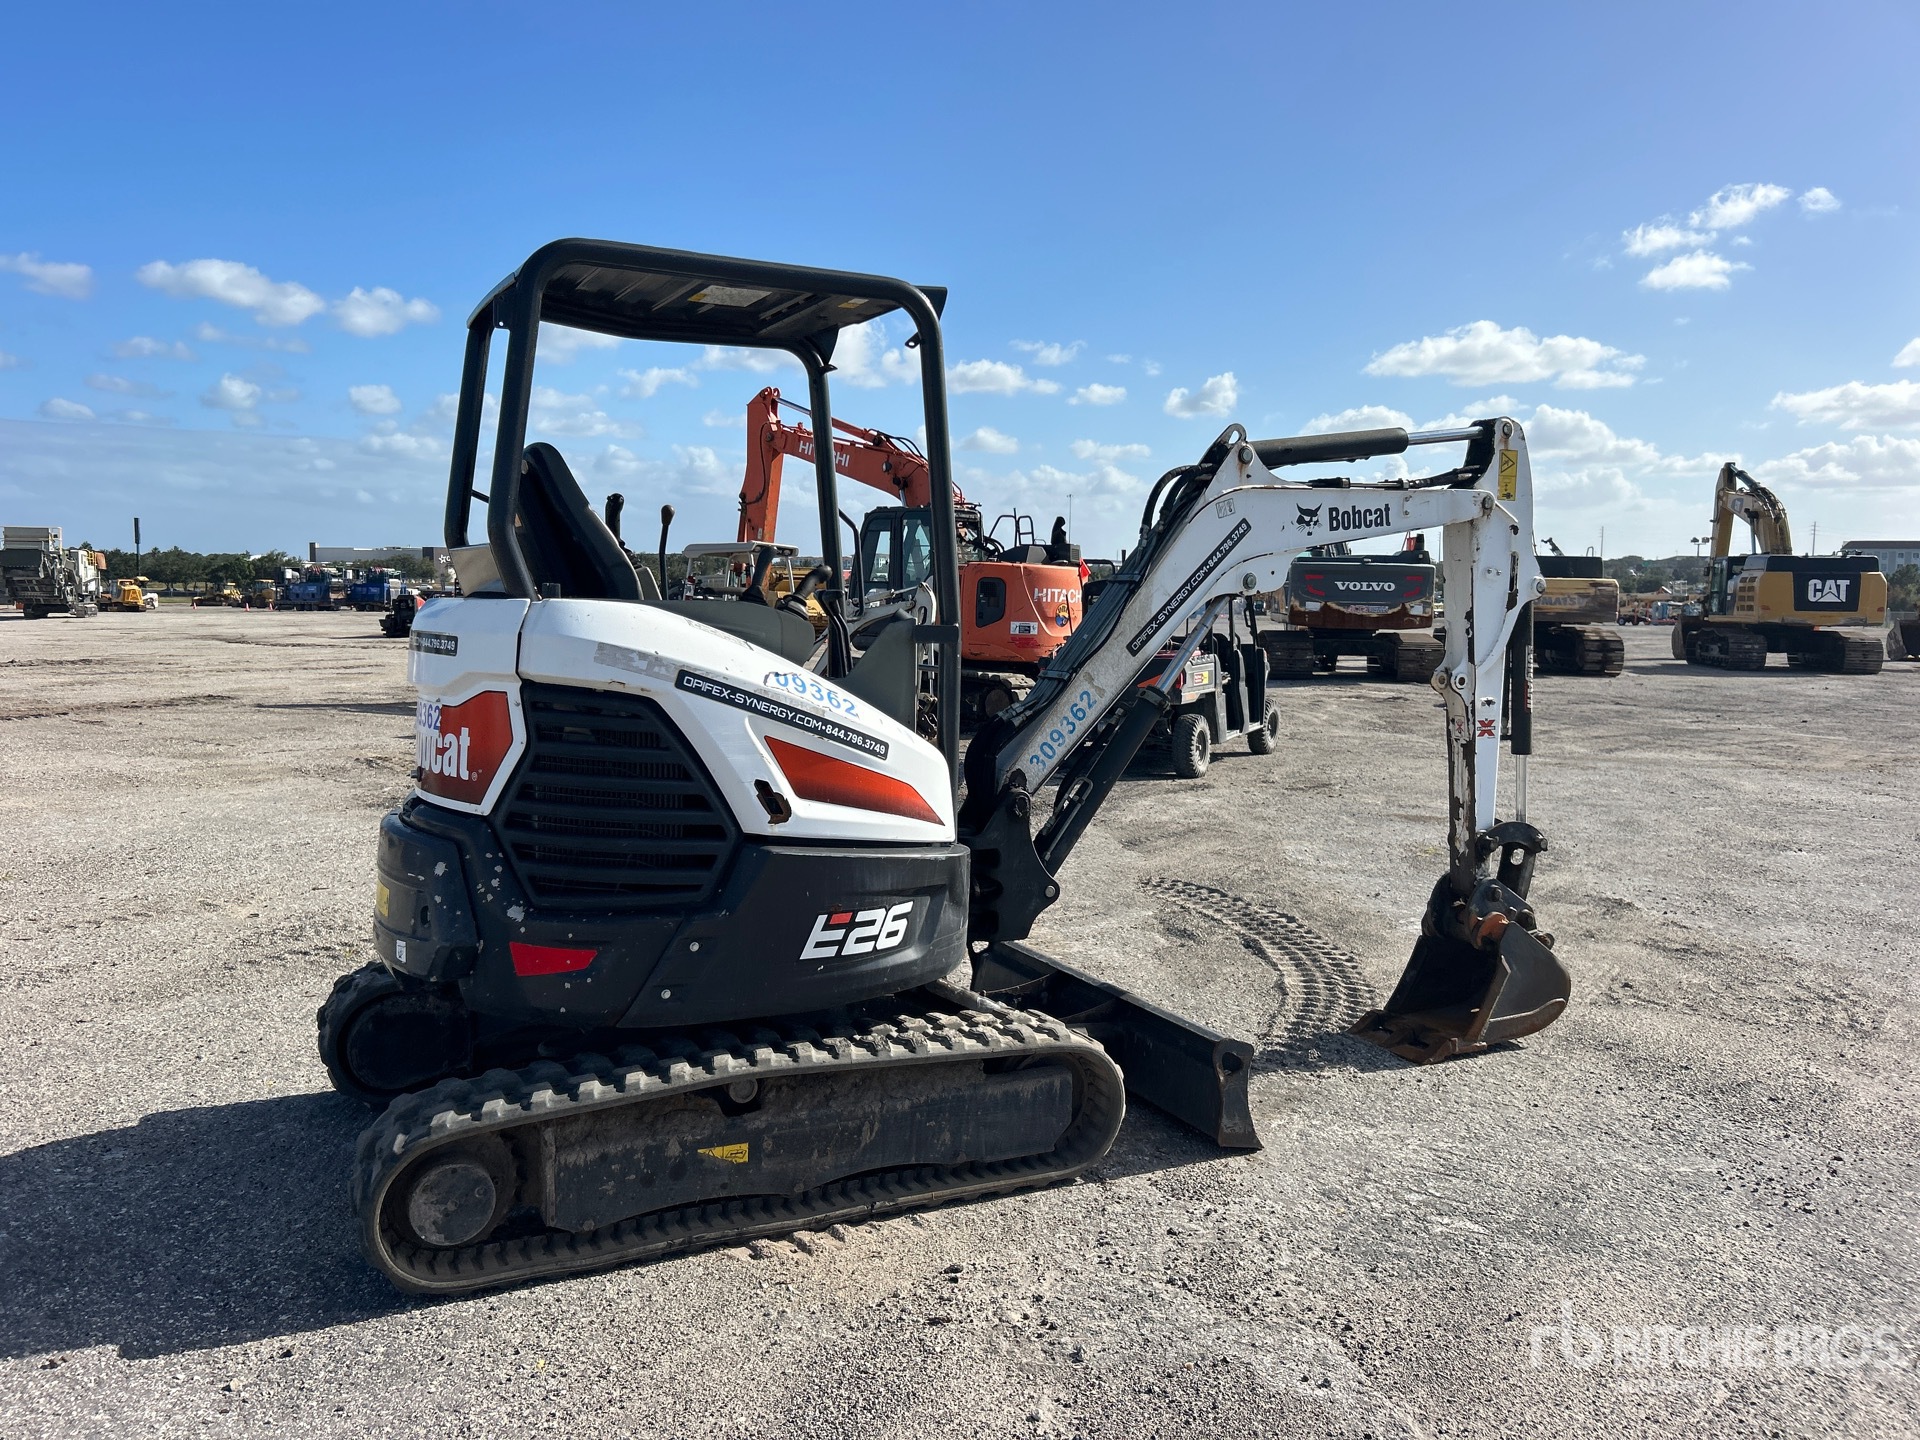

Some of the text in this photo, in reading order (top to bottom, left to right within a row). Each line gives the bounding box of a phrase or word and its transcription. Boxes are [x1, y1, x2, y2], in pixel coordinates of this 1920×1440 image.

[799, 440, 850, 467] HIHI
[1328, 503, 1391, 531] Bobcat
[1034, 587, 1082, 603] HITACH
[1335, 581, 1396, 591] VOLVO
[1808, 579, 1850, 602] CAT
[774, 672, 857, 717] 09362
[1029, 690, 1097, 771] 309362
[417, 727, 470, 780] bcat
[800, 901, 914, 959] E26
